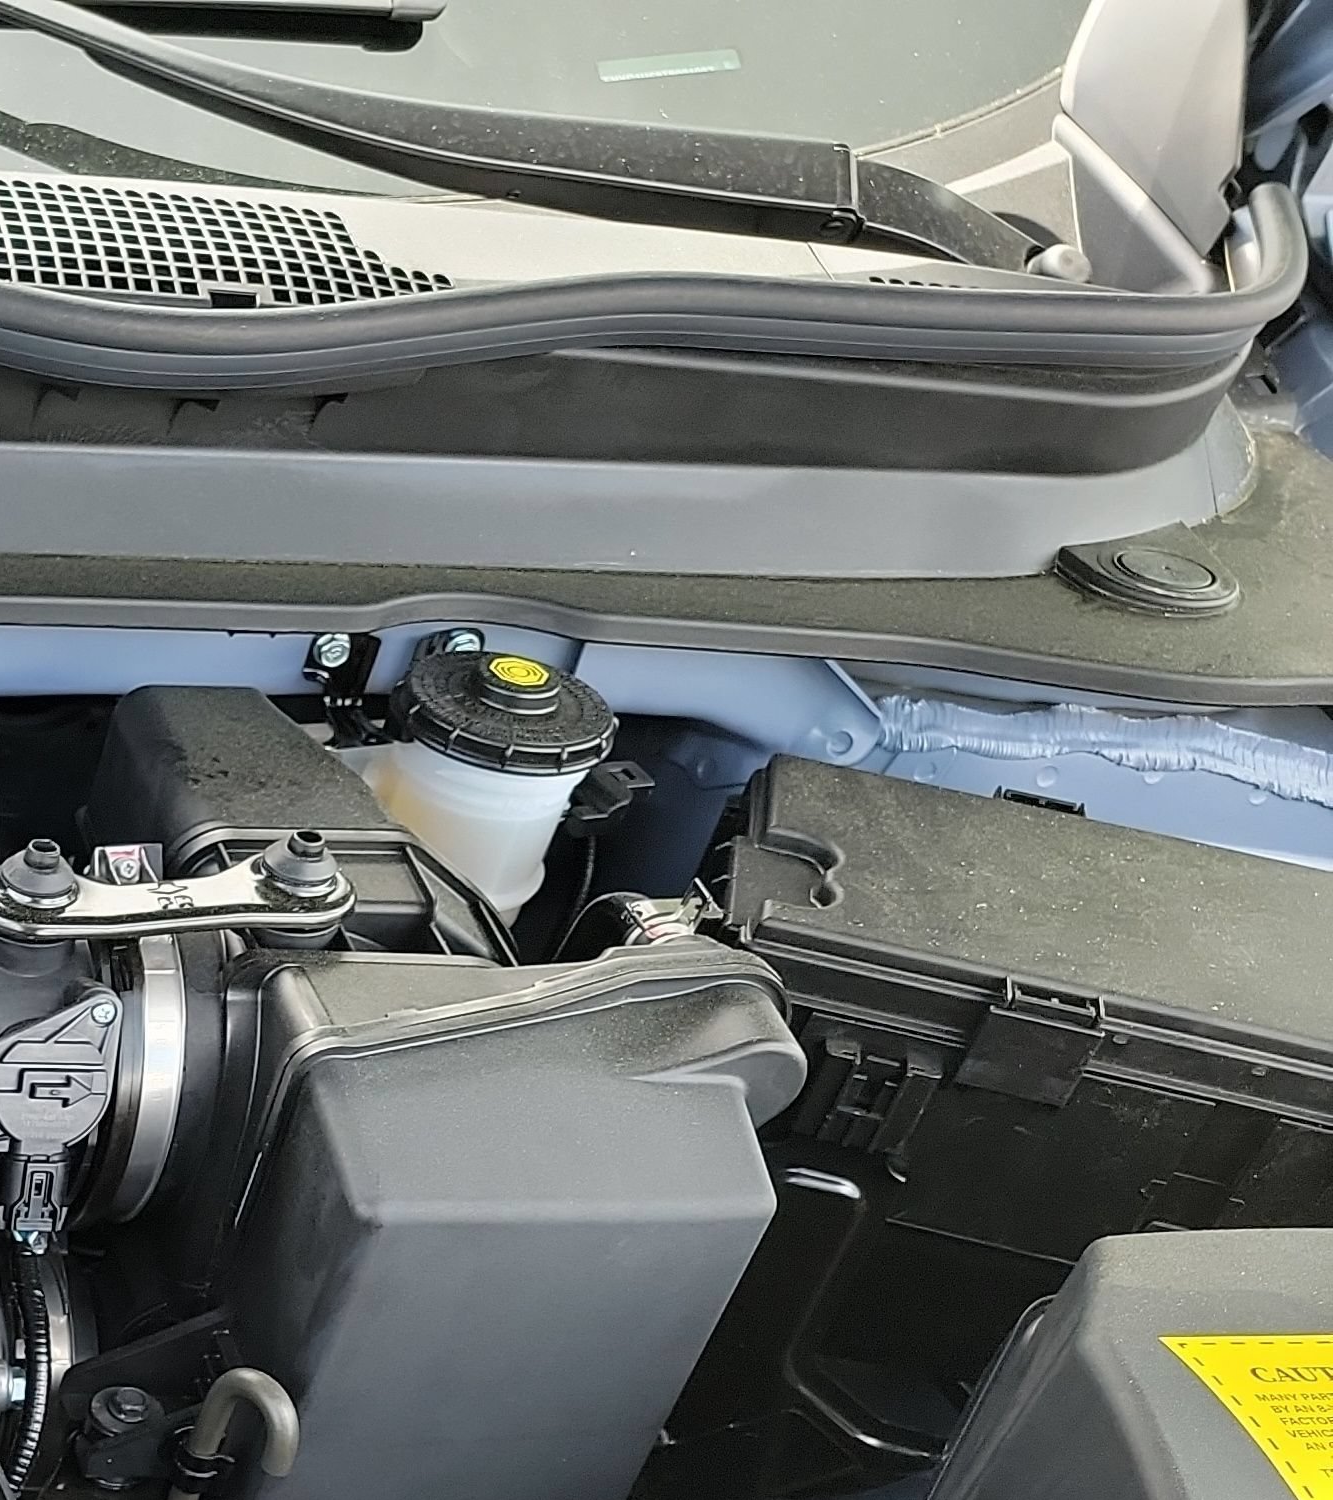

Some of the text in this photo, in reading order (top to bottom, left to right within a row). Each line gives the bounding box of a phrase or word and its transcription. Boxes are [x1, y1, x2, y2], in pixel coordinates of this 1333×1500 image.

[1254, 1393, 1297, 1402] MANY
[1270, 1405, 1290, 1413] BY
[1294, 1404, 1315, 1413] AN
[1306, 1442, 1327, 1451] AN
